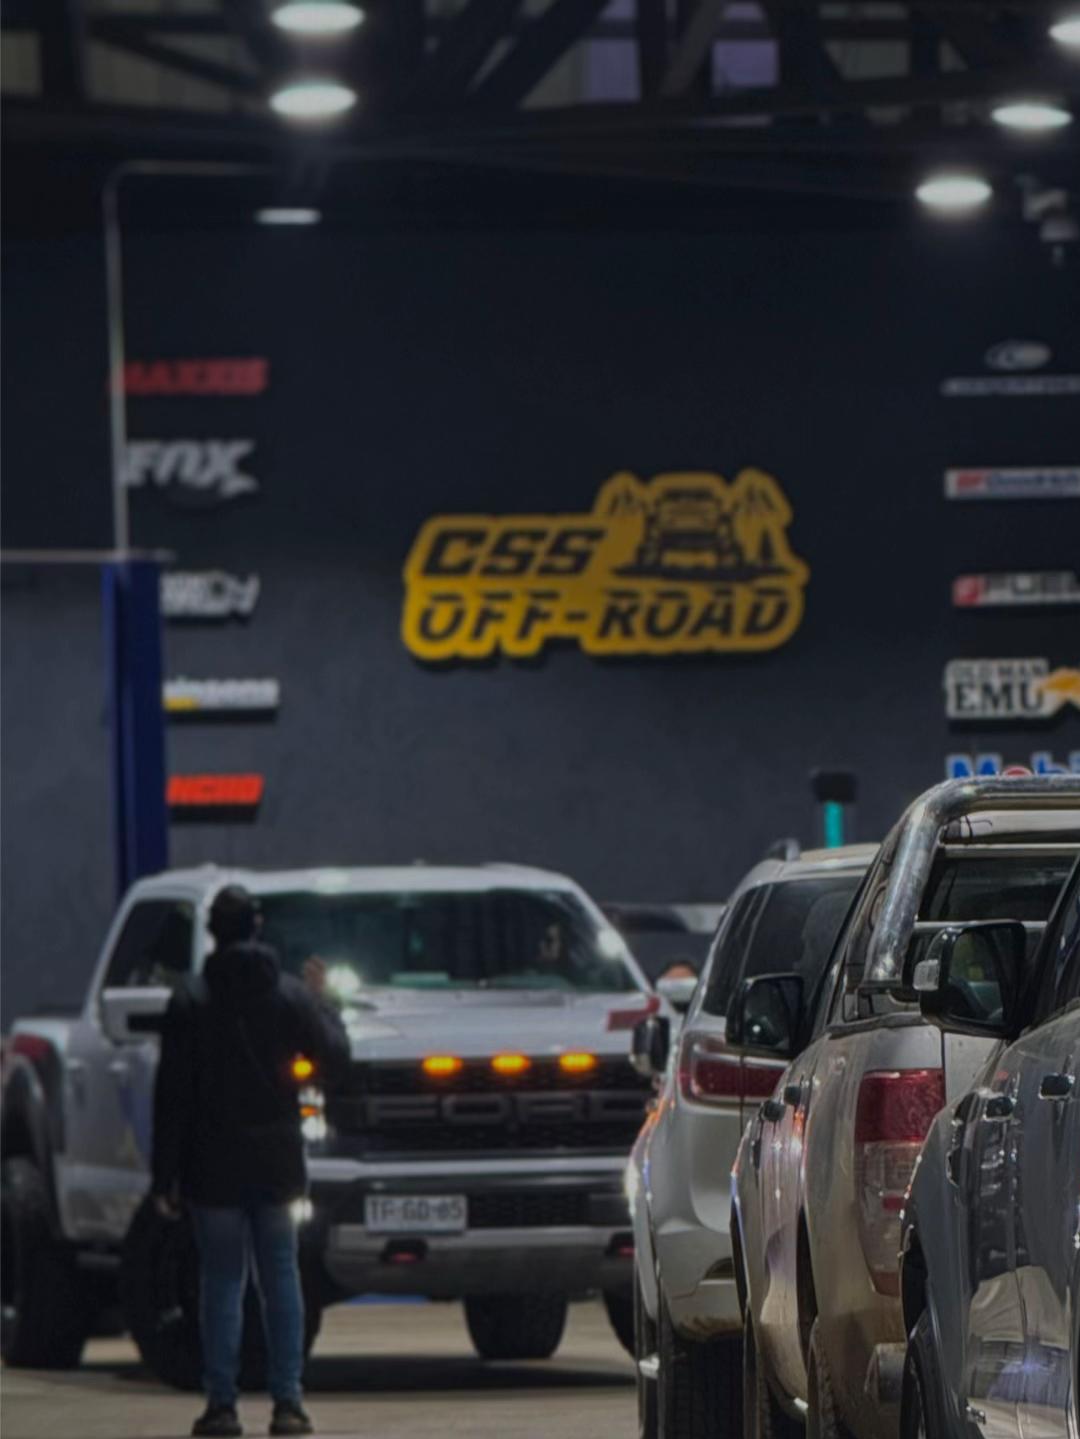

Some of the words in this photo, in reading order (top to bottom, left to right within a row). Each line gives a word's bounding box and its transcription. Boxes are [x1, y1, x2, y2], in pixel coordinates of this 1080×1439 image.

[422, 528, 606, 577] CSS
[417, 588, 789, 643] OFF-ROAD
[952, 681, 1047, 713] EMU
